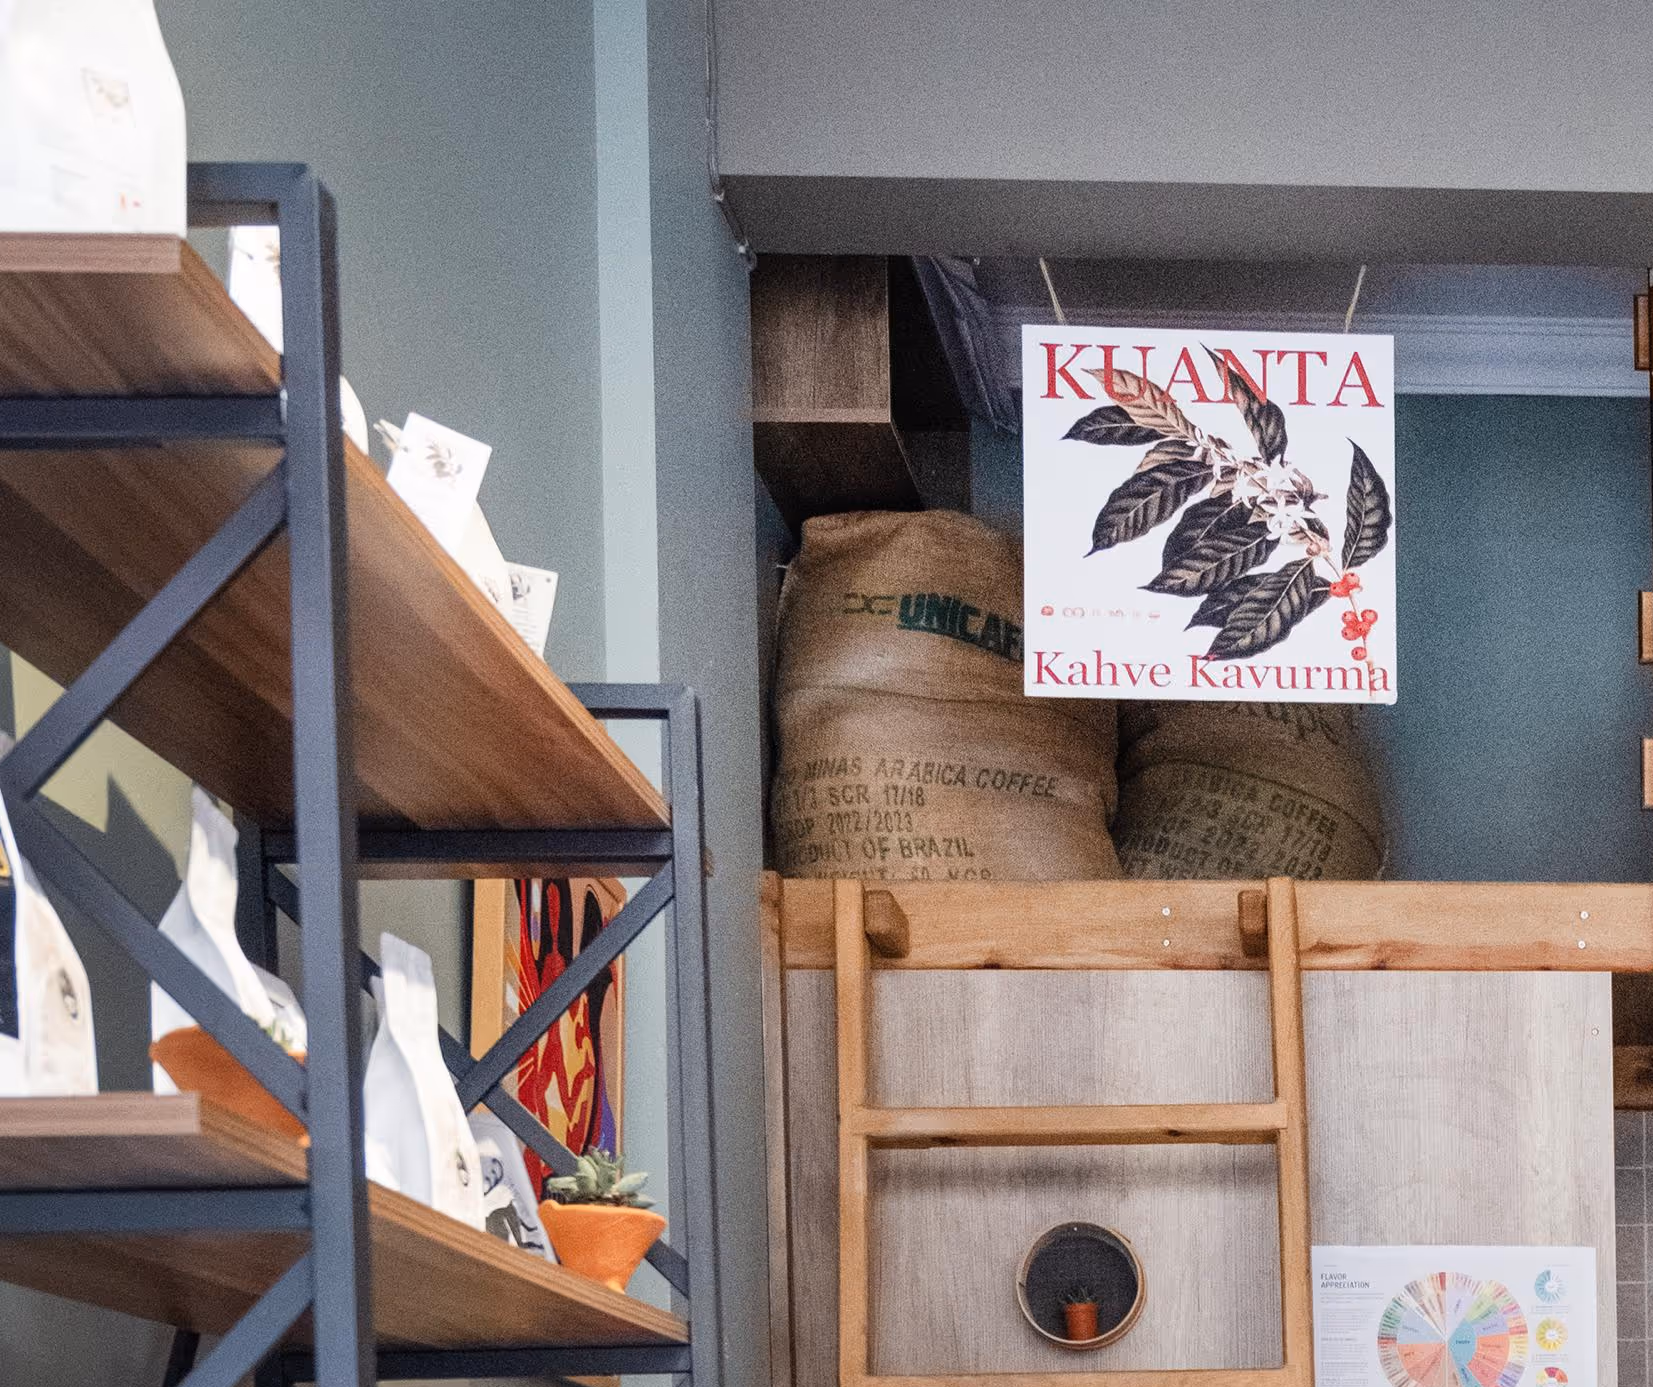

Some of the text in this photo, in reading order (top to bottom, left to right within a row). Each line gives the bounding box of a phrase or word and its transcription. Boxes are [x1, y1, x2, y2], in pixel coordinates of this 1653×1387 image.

[1039, 342, 1385, 408] KUANTA
[1033, 650, 1391, 692] Kahve Kavurma
[873, 758, 968, 788] ARABICA
[975, 767, 1060, 799] COFFEE
[828, 784, 871, 807] SCR
[883, 785, 926, 807] 17/18
[862, 836, 890, 860] OF
[899, 837, 976, 859] BRAZIL
[1320, 1272, 1347, 1281] FLAVOR
[1320, 1281, 1370, 1289] APPRECIATION
